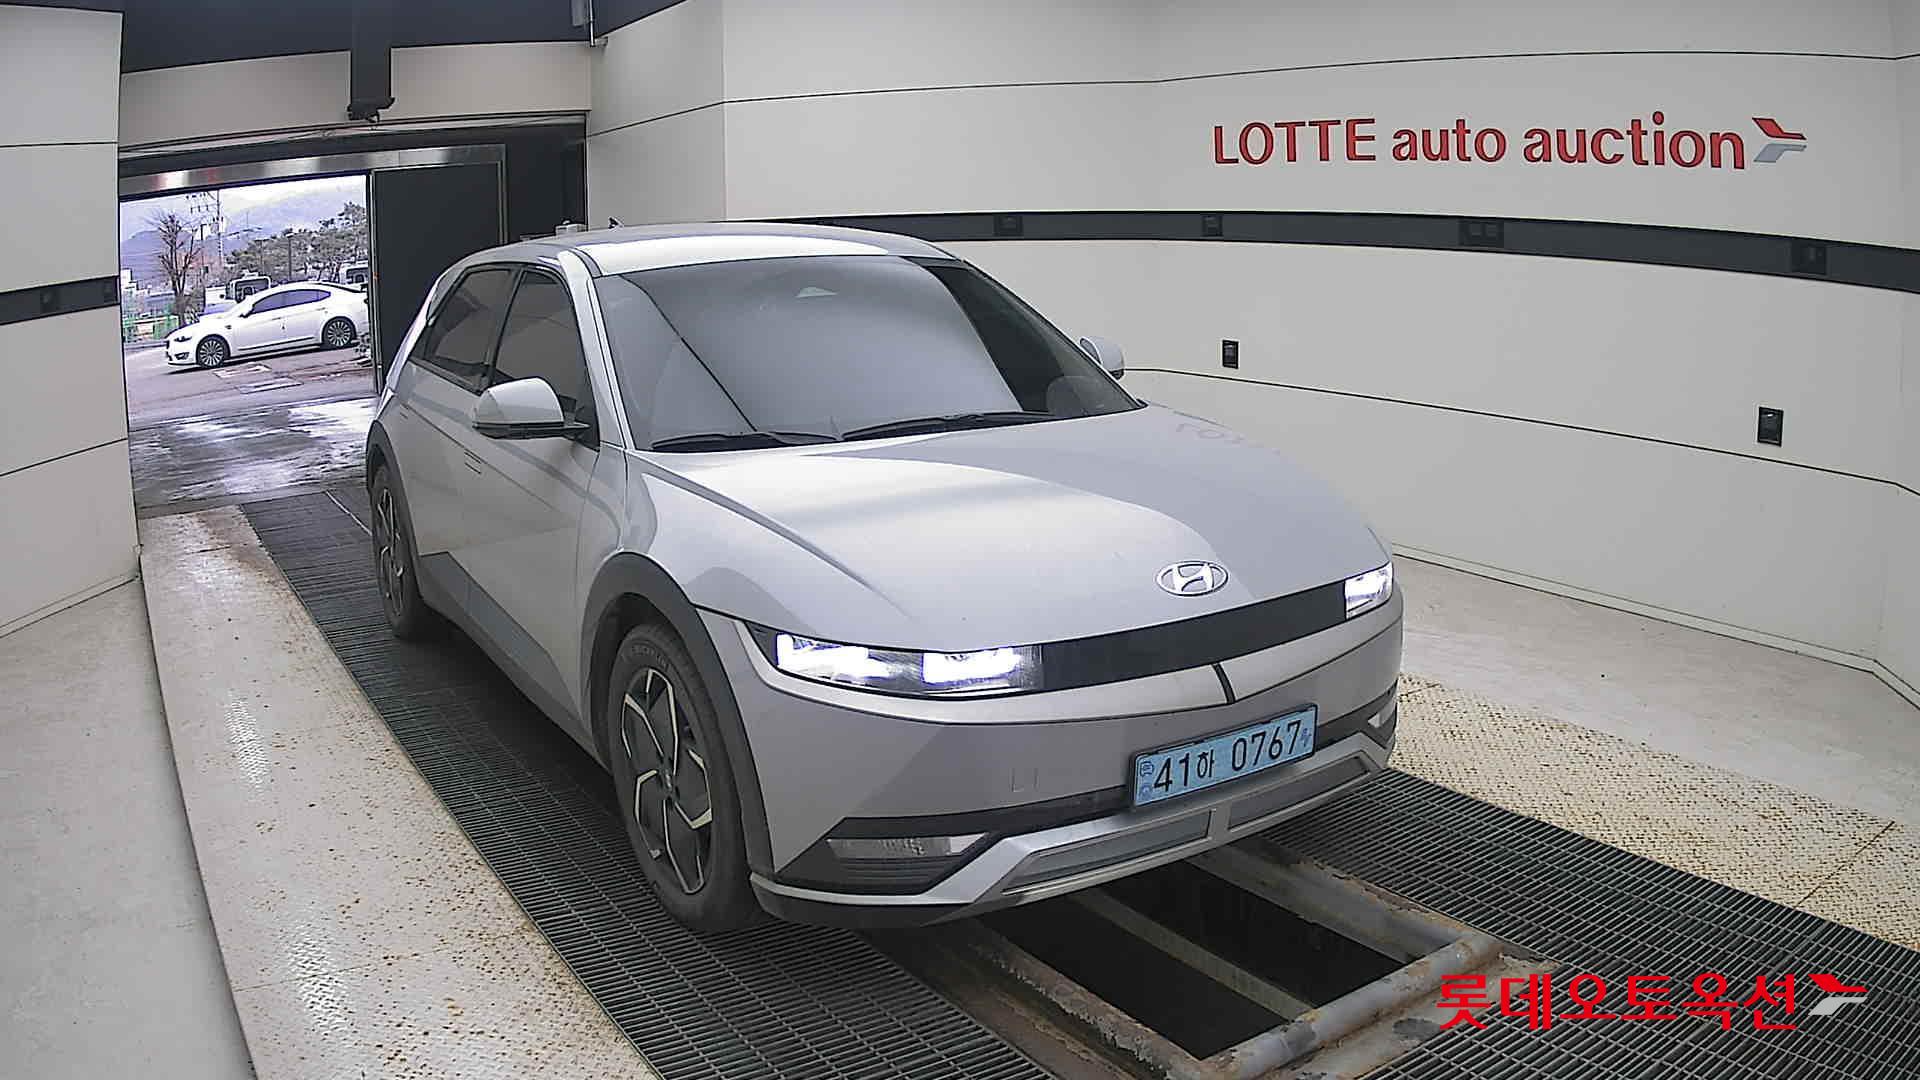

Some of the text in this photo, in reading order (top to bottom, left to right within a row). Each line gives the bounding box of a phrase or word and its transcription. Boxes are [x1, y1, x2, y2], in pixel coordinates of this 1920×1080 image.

[1213, 111, 1745, 169] LOTTE auto auction
[1153, 718, 1302, 793] 41하 0767
